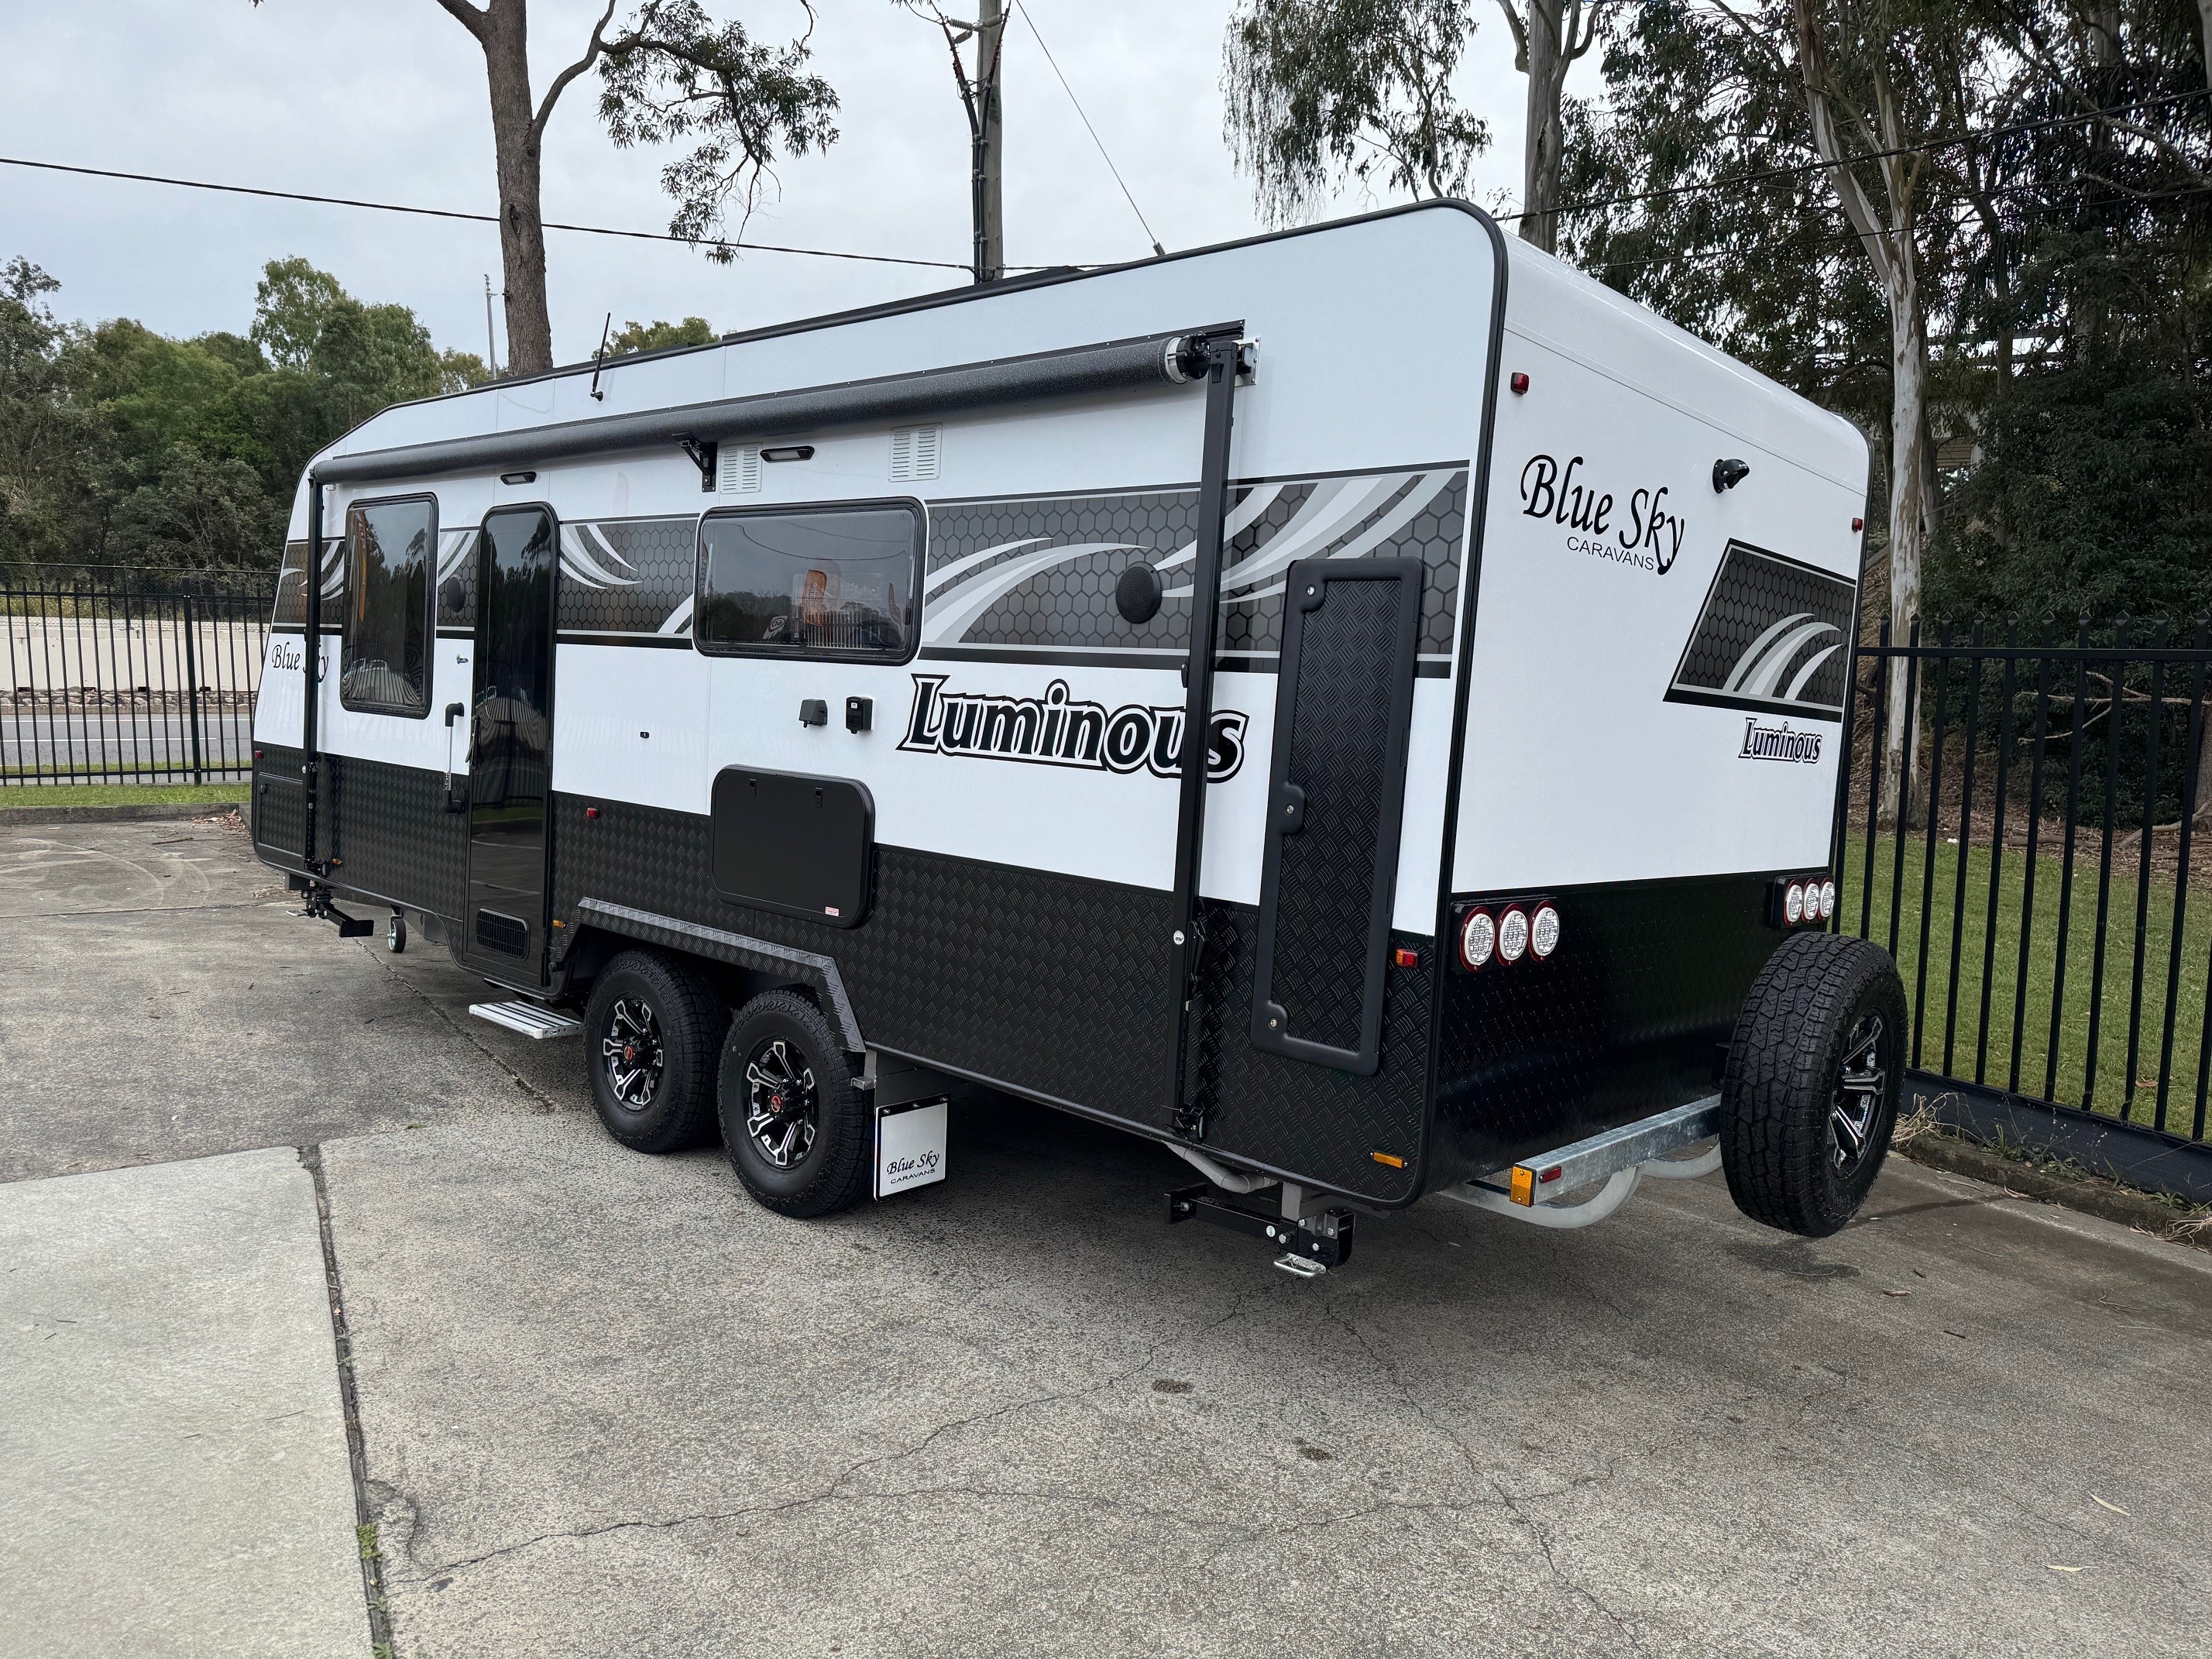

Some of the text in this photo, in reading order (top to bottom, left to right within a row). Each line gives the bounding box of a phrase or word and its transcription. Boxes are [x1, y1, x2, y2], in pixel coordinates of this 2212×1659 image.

[1520, 454, 1685, 575] Blue Sky
[1567, 536, 1654, 571] CARAVANS
[272, 641, 301, 671] Blue
[895, 673, 1250, 784] Luminous
[1738, 717, 1822, 764] Luminous
[887, 1150, 939, 1175] Blue Sky
[890, 1168, 936, 1184] CARAVANS
